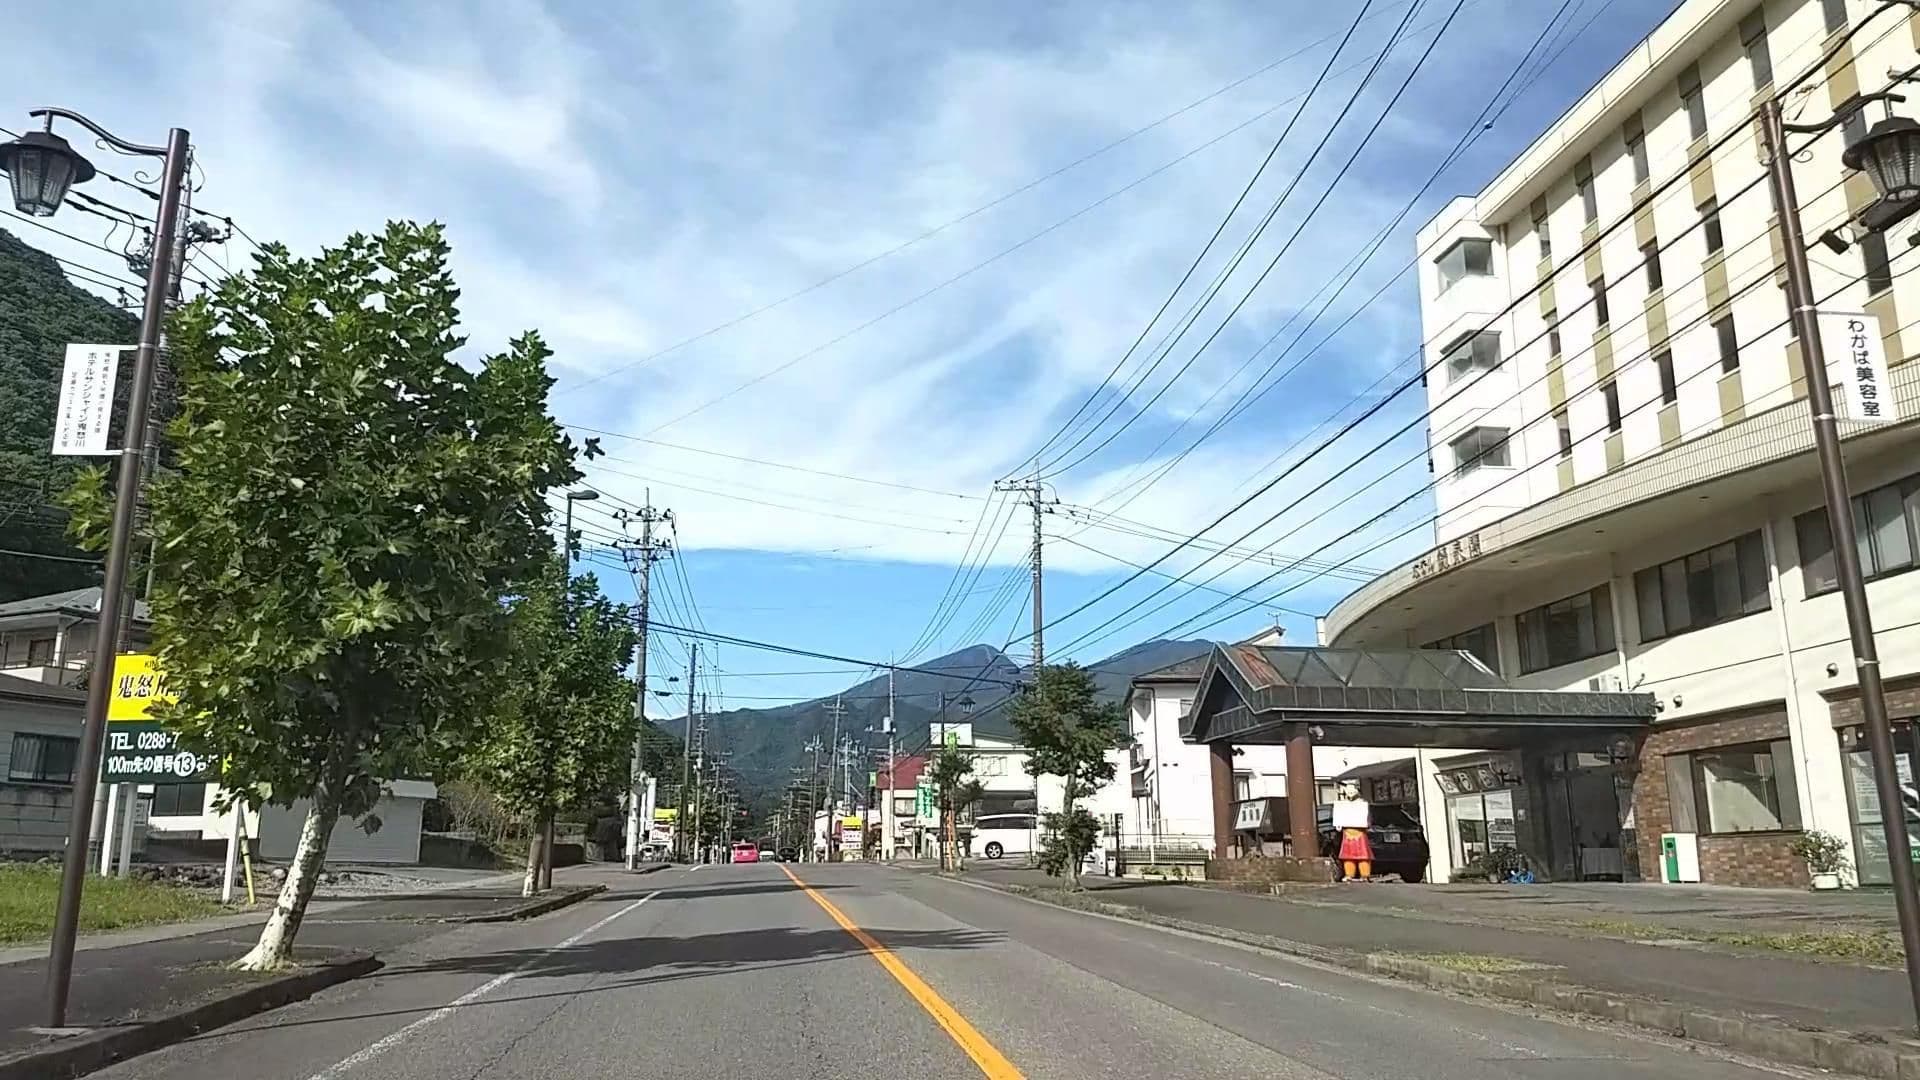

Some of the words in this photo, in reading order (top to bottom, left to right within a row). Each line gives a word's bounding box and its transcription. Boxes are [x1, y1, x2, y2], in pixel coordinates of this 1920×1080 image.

[1848, 319, 1880, 417] わかば美容室
[110, 732, 134, 750] TEL
